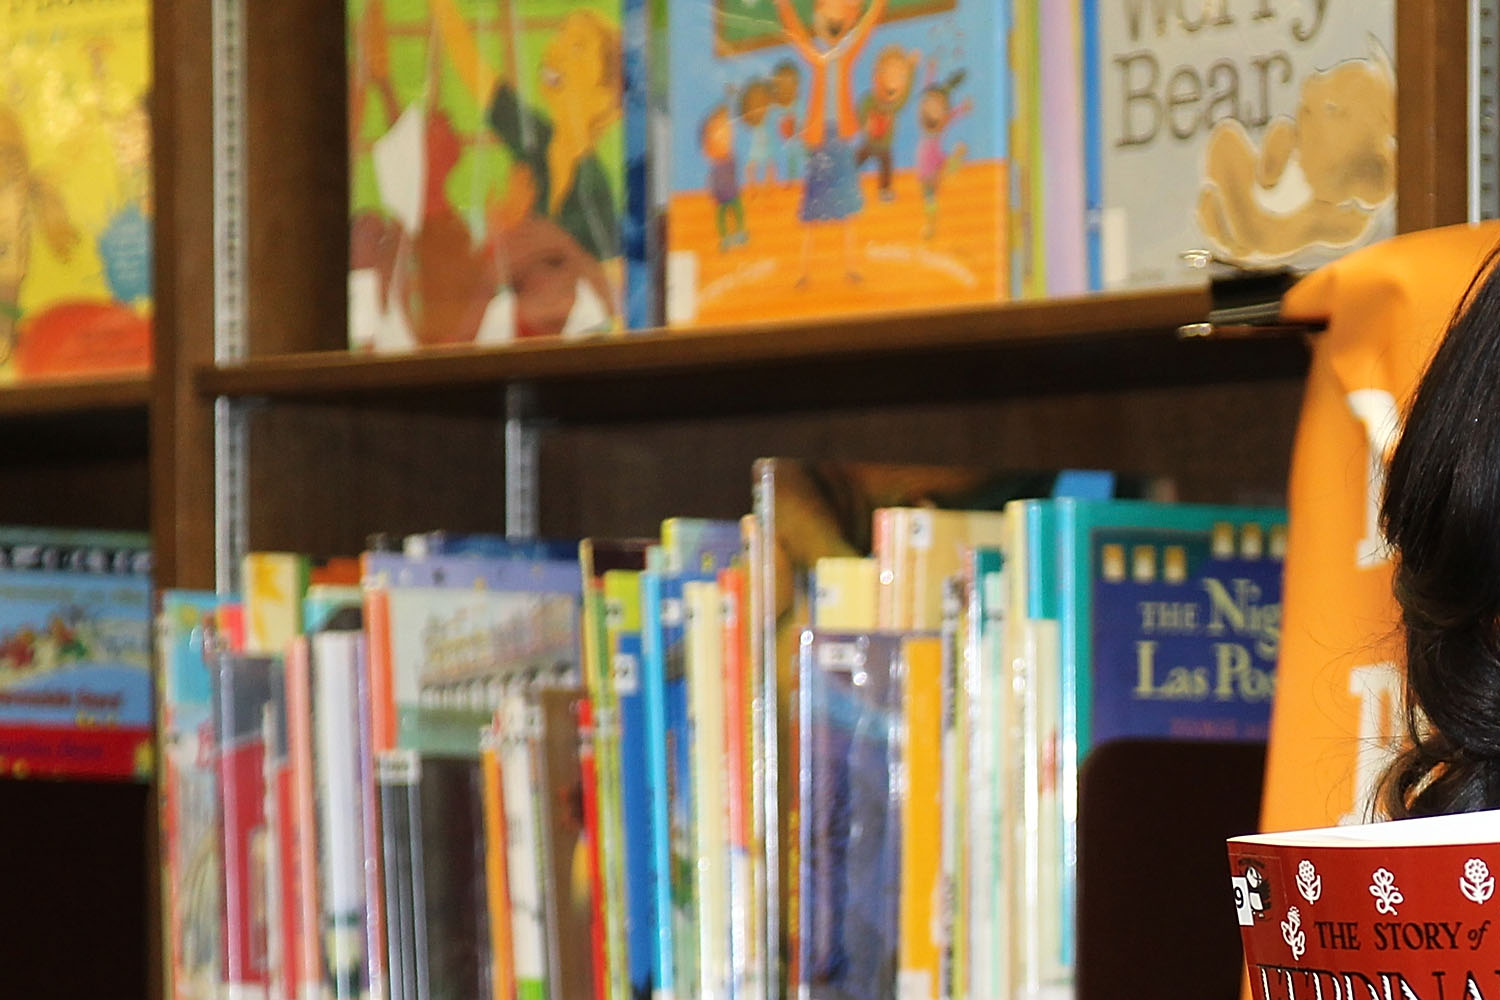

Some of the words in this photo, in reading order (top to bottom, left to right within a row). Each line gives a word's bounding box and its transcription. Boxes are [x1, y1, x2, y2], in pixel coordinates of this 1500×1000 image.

[1112, 49, 1293, 148] Bear
[1138, 601, 1198, 630] THE
[1133, 639, 1209, 699] Las
[1314, 921, 1361, 951] THE
[1375, 921, 1460, 951] STORY
[1467, 920, 1491, 950] of
